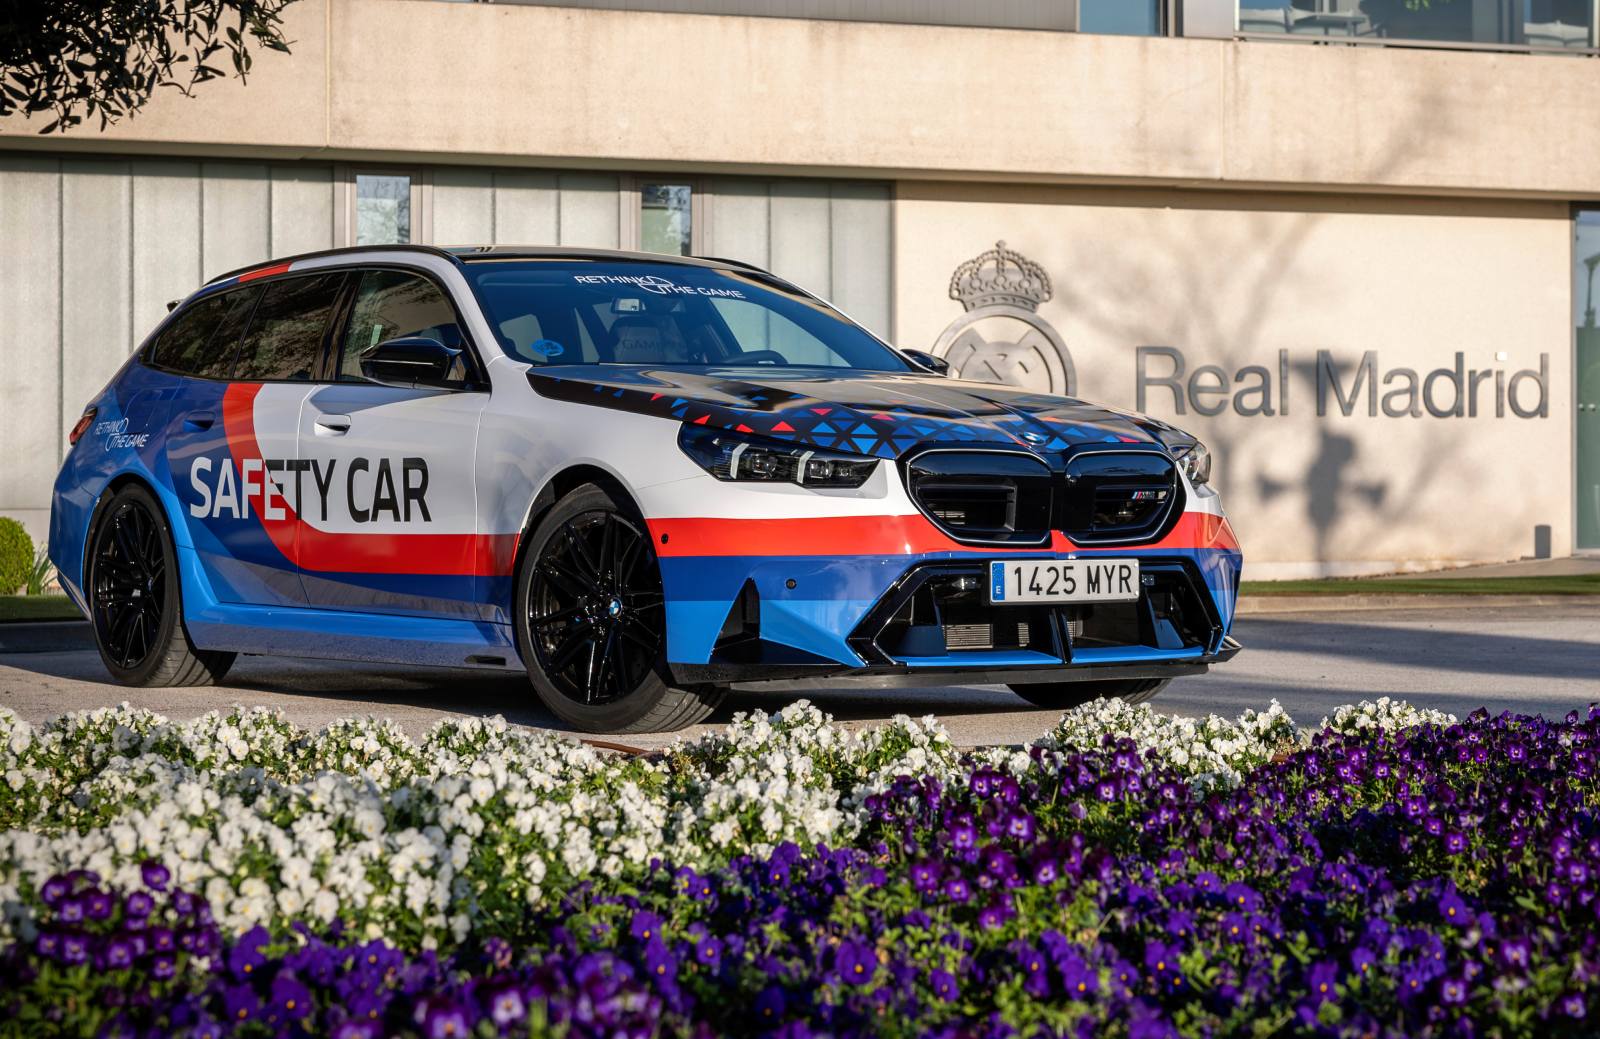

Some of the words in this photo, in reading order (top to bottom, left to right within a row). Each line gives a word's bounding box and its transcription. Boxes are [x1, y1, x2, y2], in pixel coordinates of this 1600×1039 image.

[573, 275, 652, 285] RETHINK
[660, 285, 698, 295] THE
[697, 287, 747, 299] GAME
[1136, 346, 1288, 416] Real
[1316, 349, 1549, 418] Madrid
[190, 457, 336, 521] SAFETY
[347, 457, 432, 523] CAR
[995, 585, 1002, 594] E
[1014, 565, 1077, 596] 1425
[1086, 564, 1132, 595] MYR
